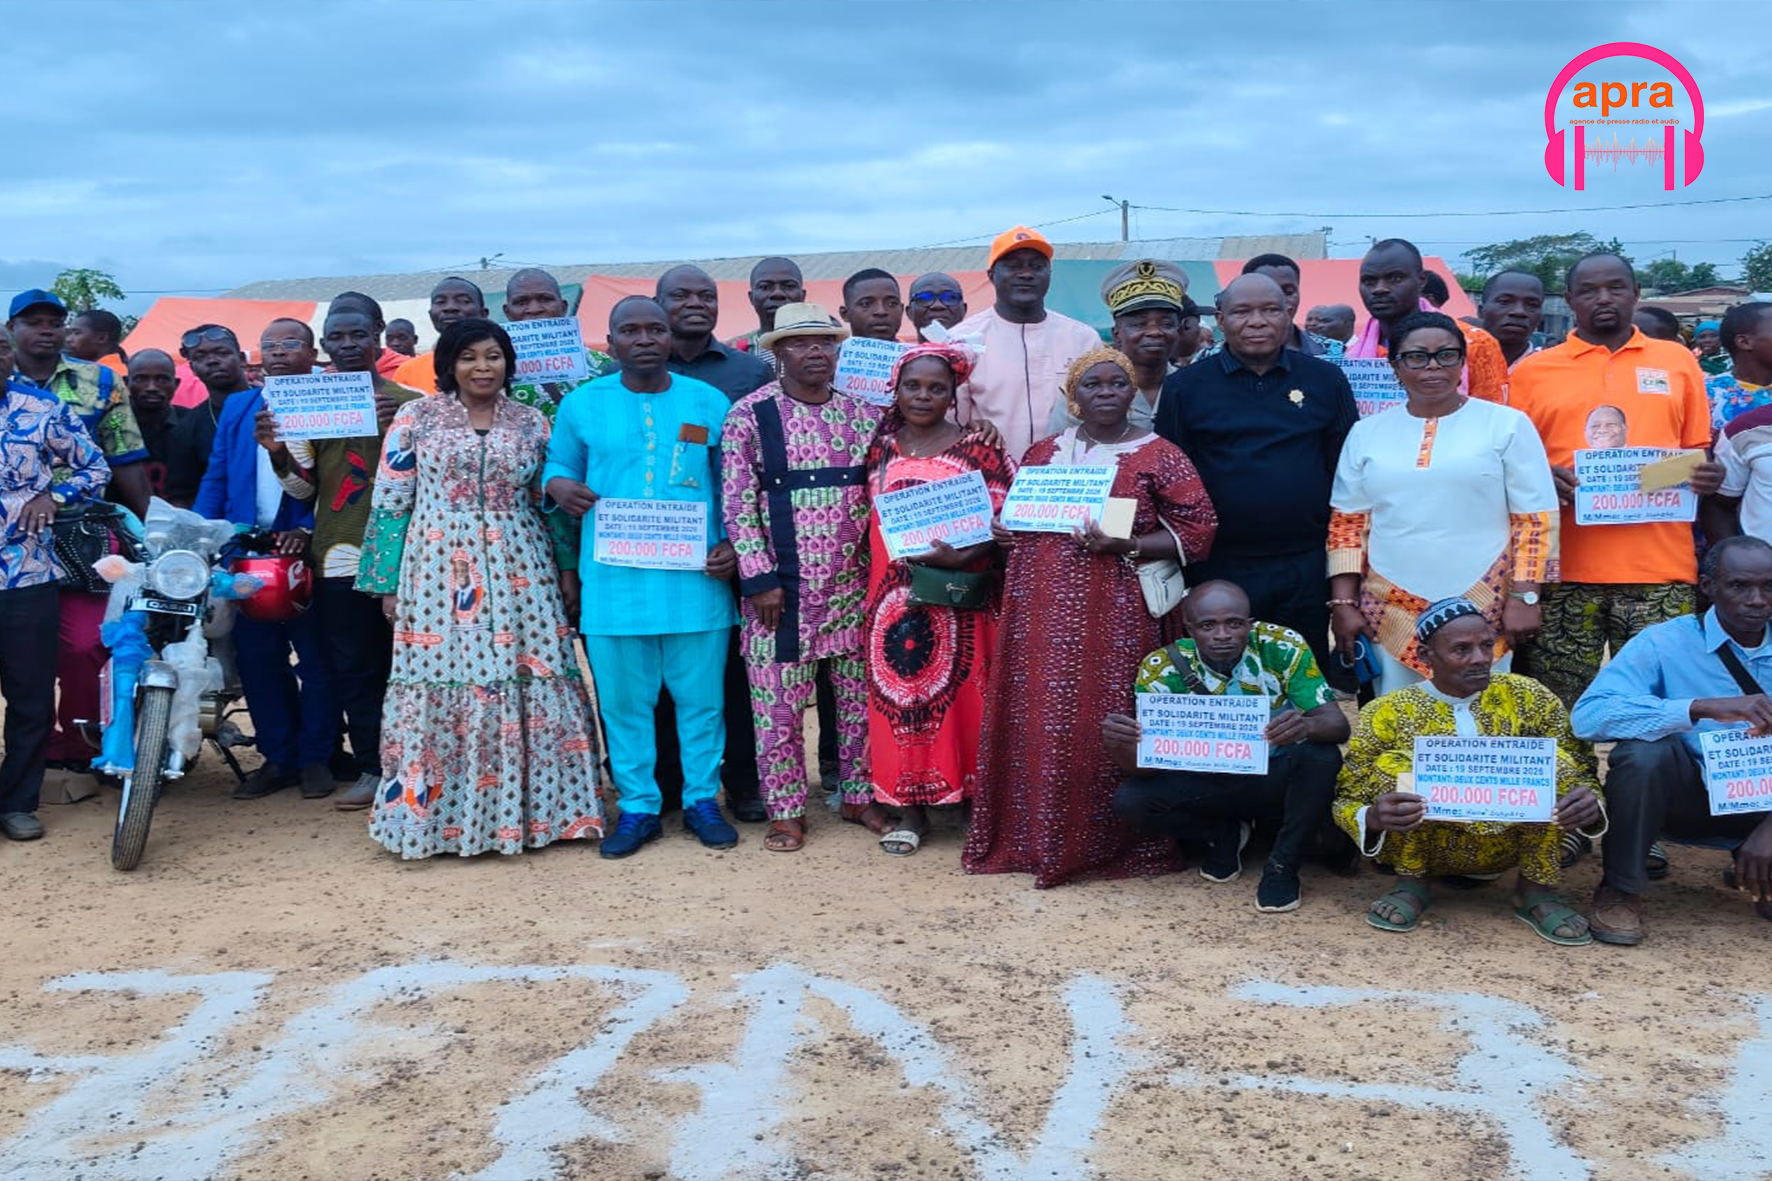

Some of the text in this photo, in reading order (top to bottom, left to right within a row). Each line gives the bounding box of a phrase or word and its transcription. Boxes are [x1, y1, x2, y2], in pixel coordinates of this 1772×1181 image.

[507, 319, 571, 332] ATION ENTRAIDE
[542, 330, 578, 340] MILITANT
[850, 339, 895, 351] OPERATION
[855, 351, 896, 362] SOLIDARIT
[519, 356, 574, 374] .000 FCFA
[846, 375, 886, 392] 200.00
[1585, 450, 1683, 459] OPERATION ENTRA
[1578, 463, 1646, 474] ET SOLIDARI
[1592, 491, 1681, 510] 200.000 FCFA
[881, 508, 892, 518] ET
[951, 513, 985, 534] FCFA
[1149, 696, 1258, 707] OPERATION ENTRAIDE
[1157, 709, 1214, 719] SOLIDARITE
[1218, 712, 1265, 722] MILITANT
[1188, 721, 1235, 729] SEPTEMBRE
[1713, 731, 1772, 743] OPERA
[1154, 738, 1252, 759] 200.000 FCFA
[1426, 738, 1544, 749] OPERATION ENTRAIDE
[1417, 753, 1551, 764] ET SOLIDARITE MILITANT
[1708, 750, 1721, 760] ET
[1468, 765, 1520, 774] SEPTEMBRE
[1718, 760, 1740, 769] DATE
[1430, 785, 1538, 807] 200.000 FCFA
